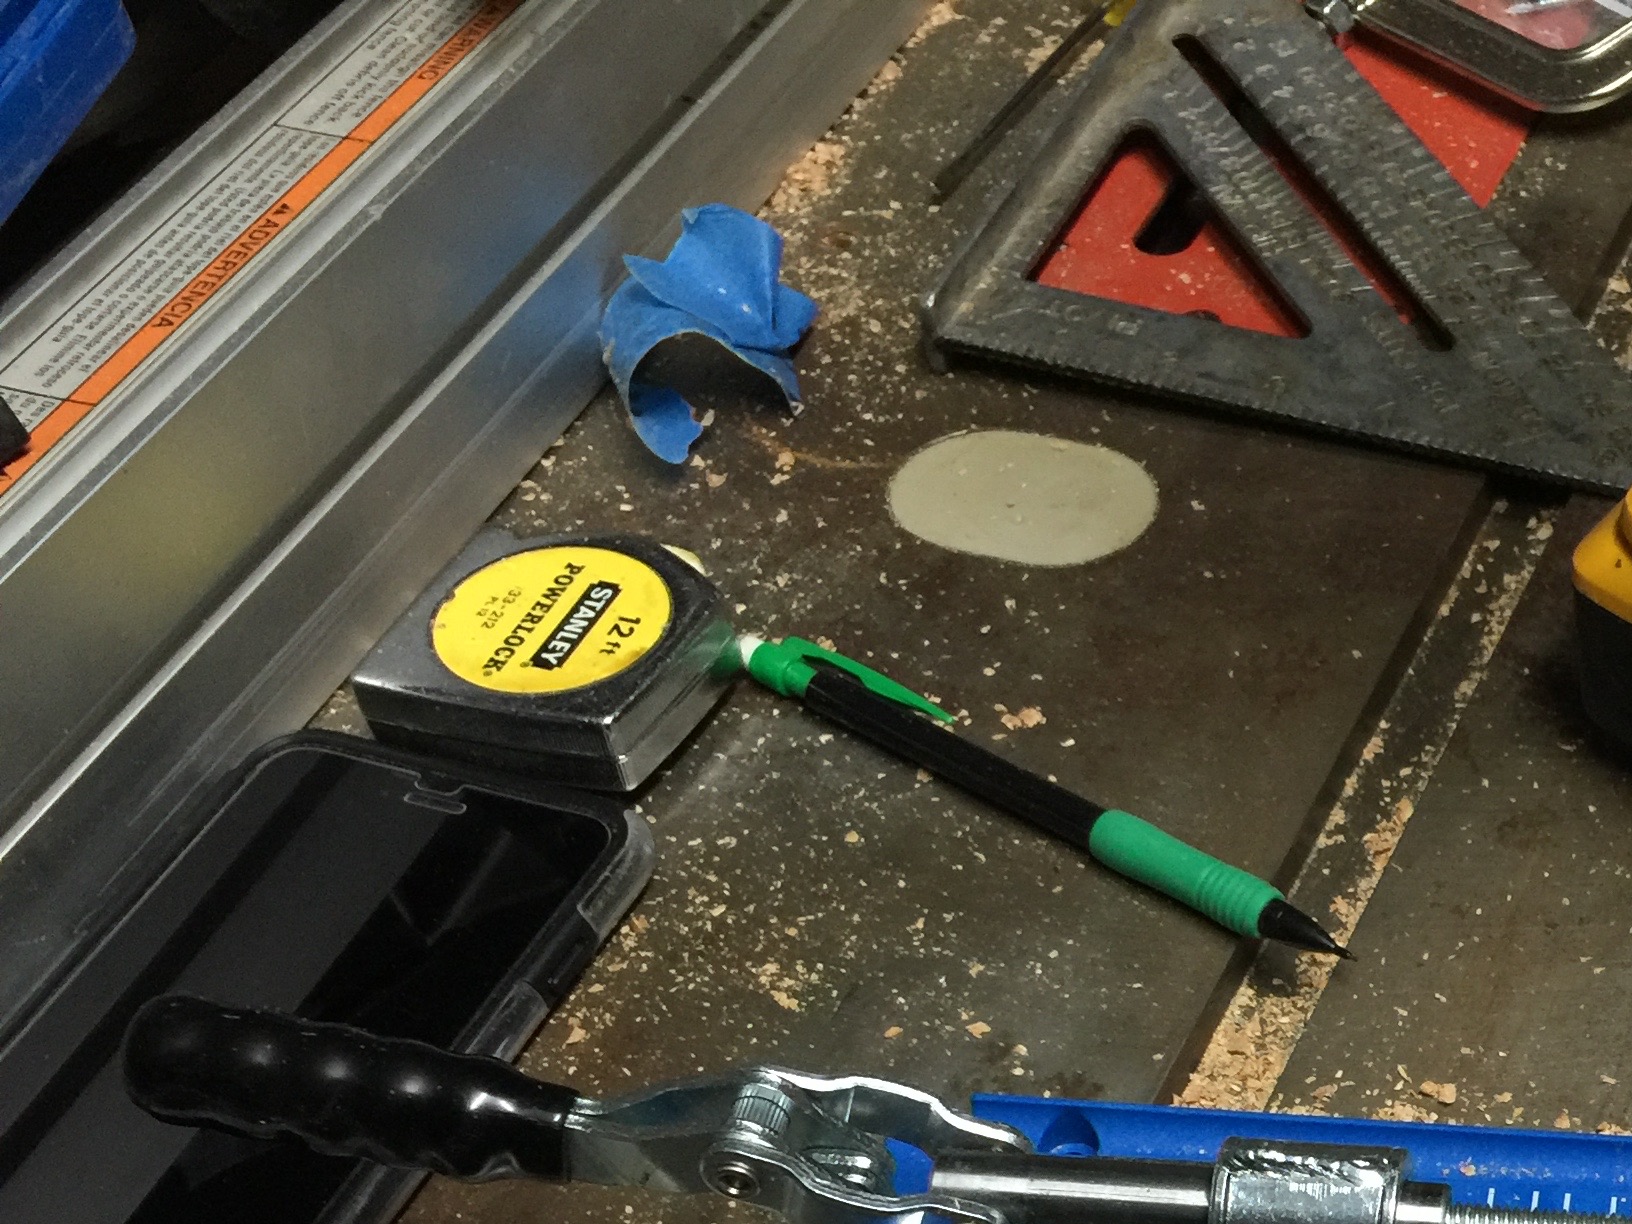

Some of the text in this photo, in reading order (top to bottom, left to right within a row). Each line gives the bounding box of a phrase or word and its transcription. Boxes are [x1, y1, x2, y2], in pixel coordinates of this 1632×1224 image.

[150, 217, 284, 330] ADVERTENCIA
[482, 562, 586, 673] POWERLOCK
[541, 586, 613, 665] STANLEY
[600, 616, 641, 655] 12 ft
